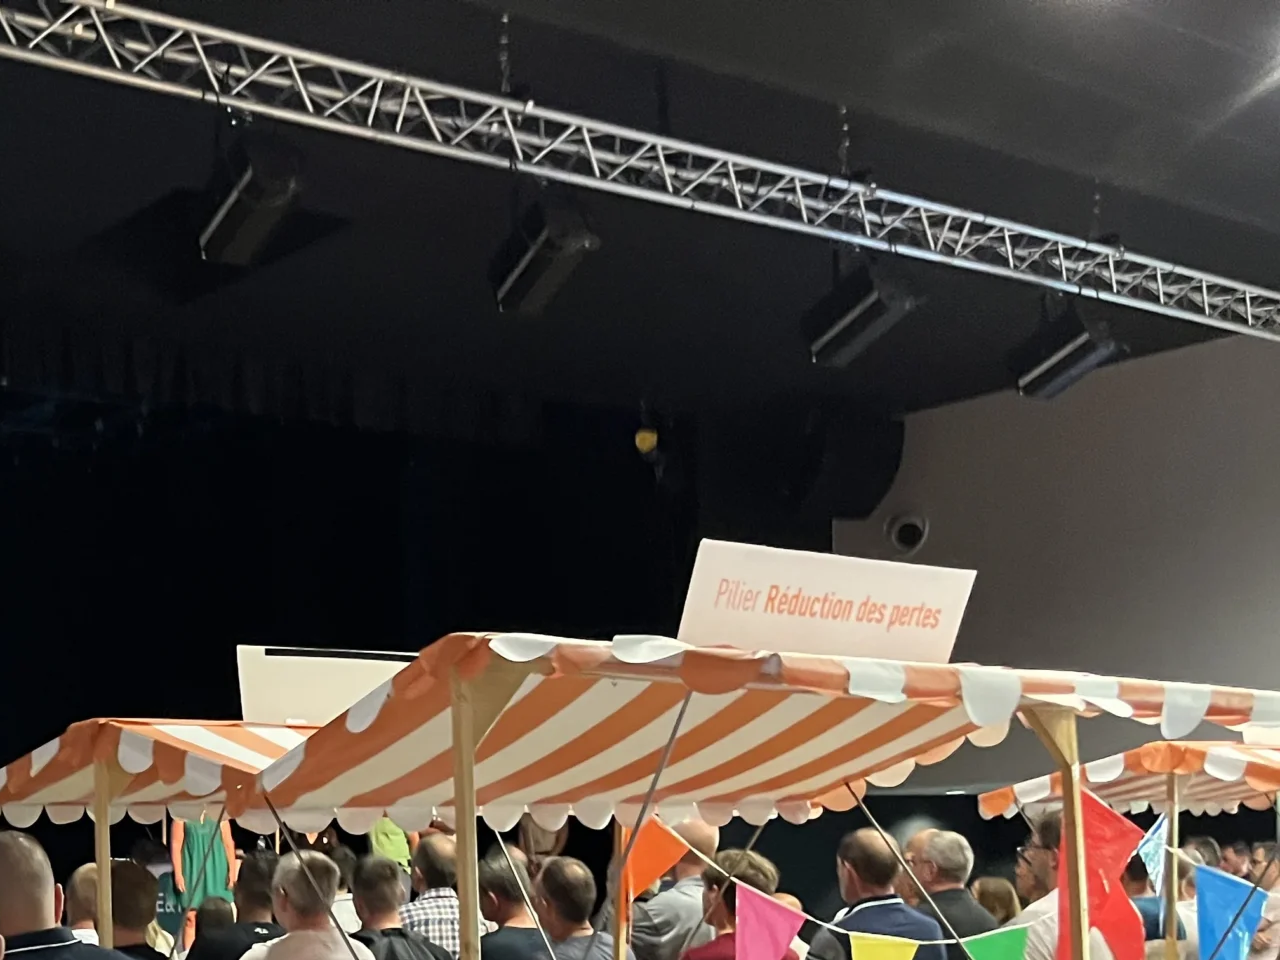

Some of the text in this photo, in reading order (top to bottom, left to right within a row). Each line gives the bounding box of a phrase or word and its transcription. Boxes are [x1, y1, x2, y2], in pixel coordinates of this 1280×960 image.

[714, 578, 942, 632] Pilier Réduction des pertes
